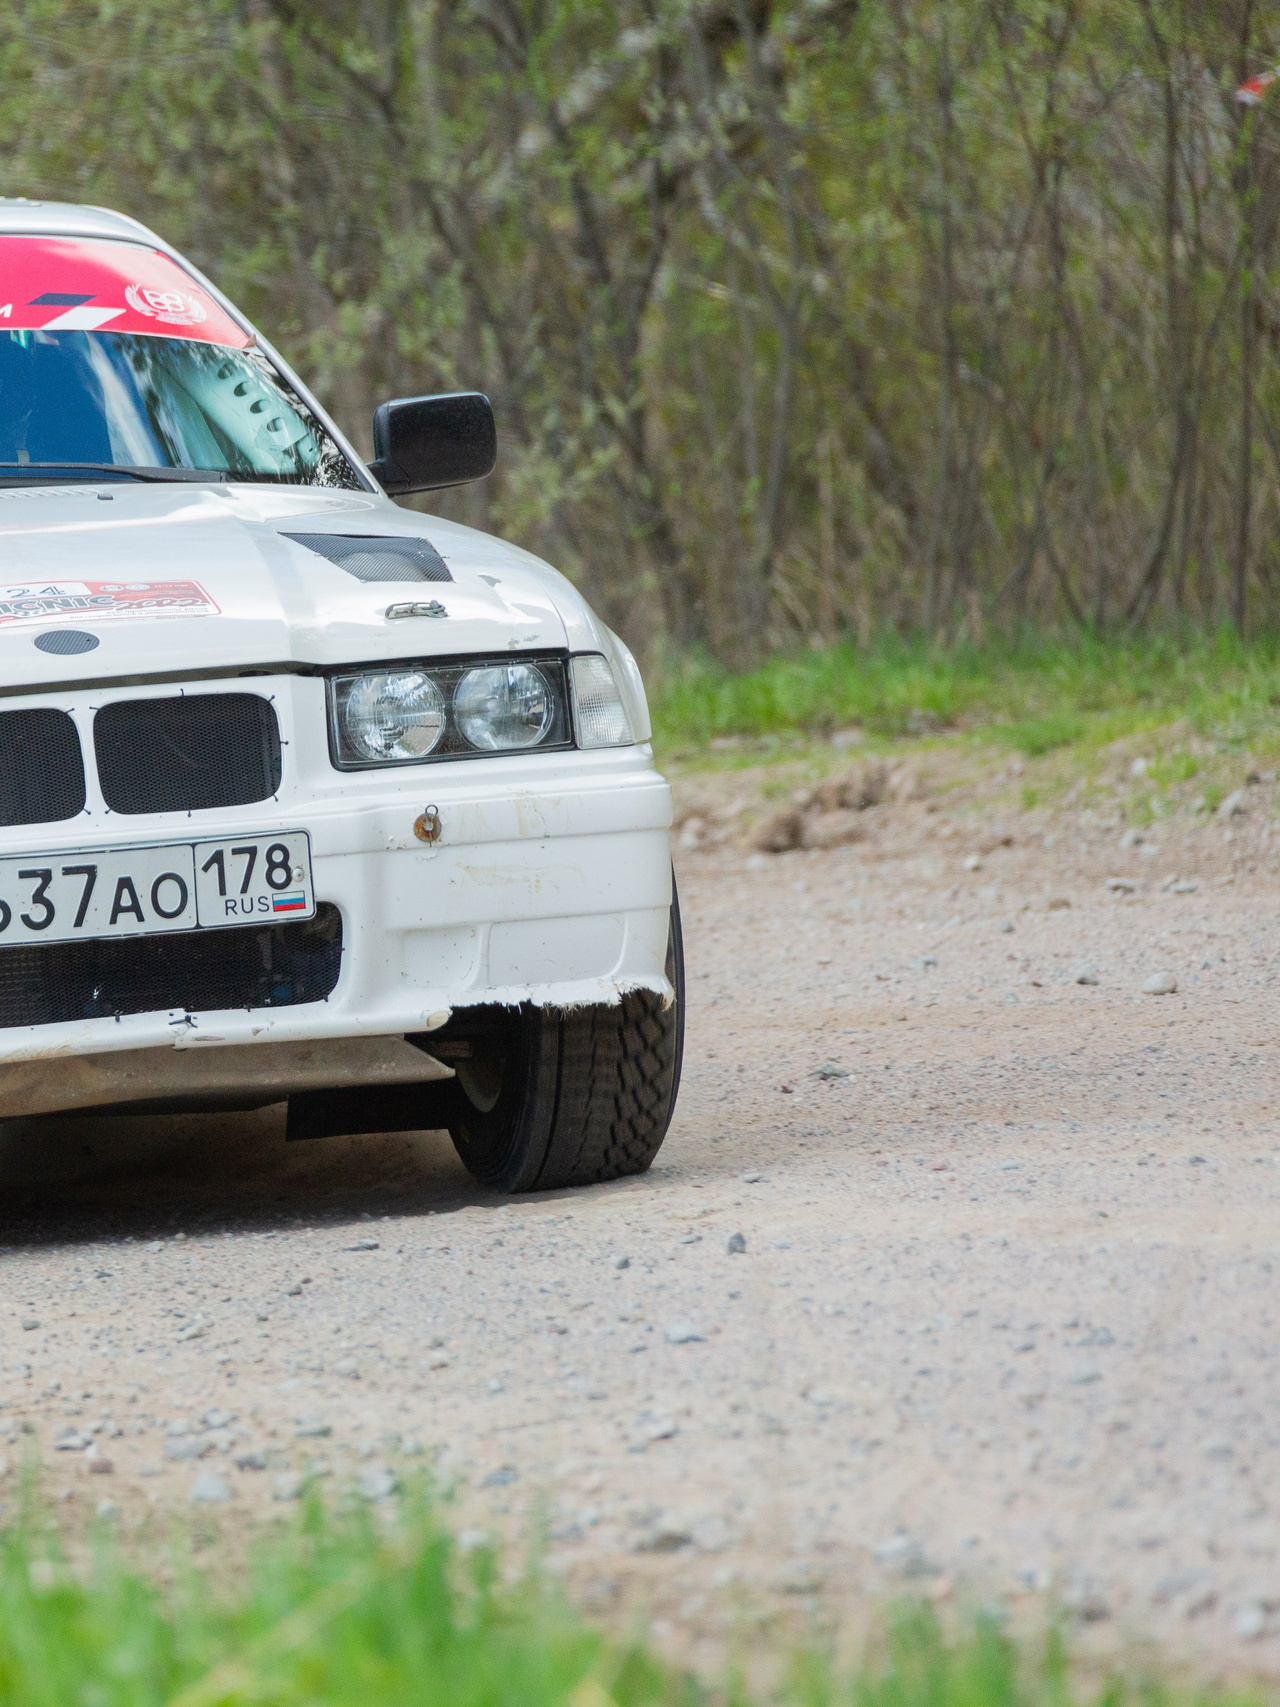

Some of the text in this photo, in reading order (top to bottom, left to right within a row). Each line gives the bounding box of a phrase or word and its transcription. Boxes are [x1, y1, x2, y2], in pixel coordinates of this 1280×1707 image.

[6, 585, 66, 599] 24
[201, 842, 294, 896] 178
[225, 895, 270, 917] RUS
